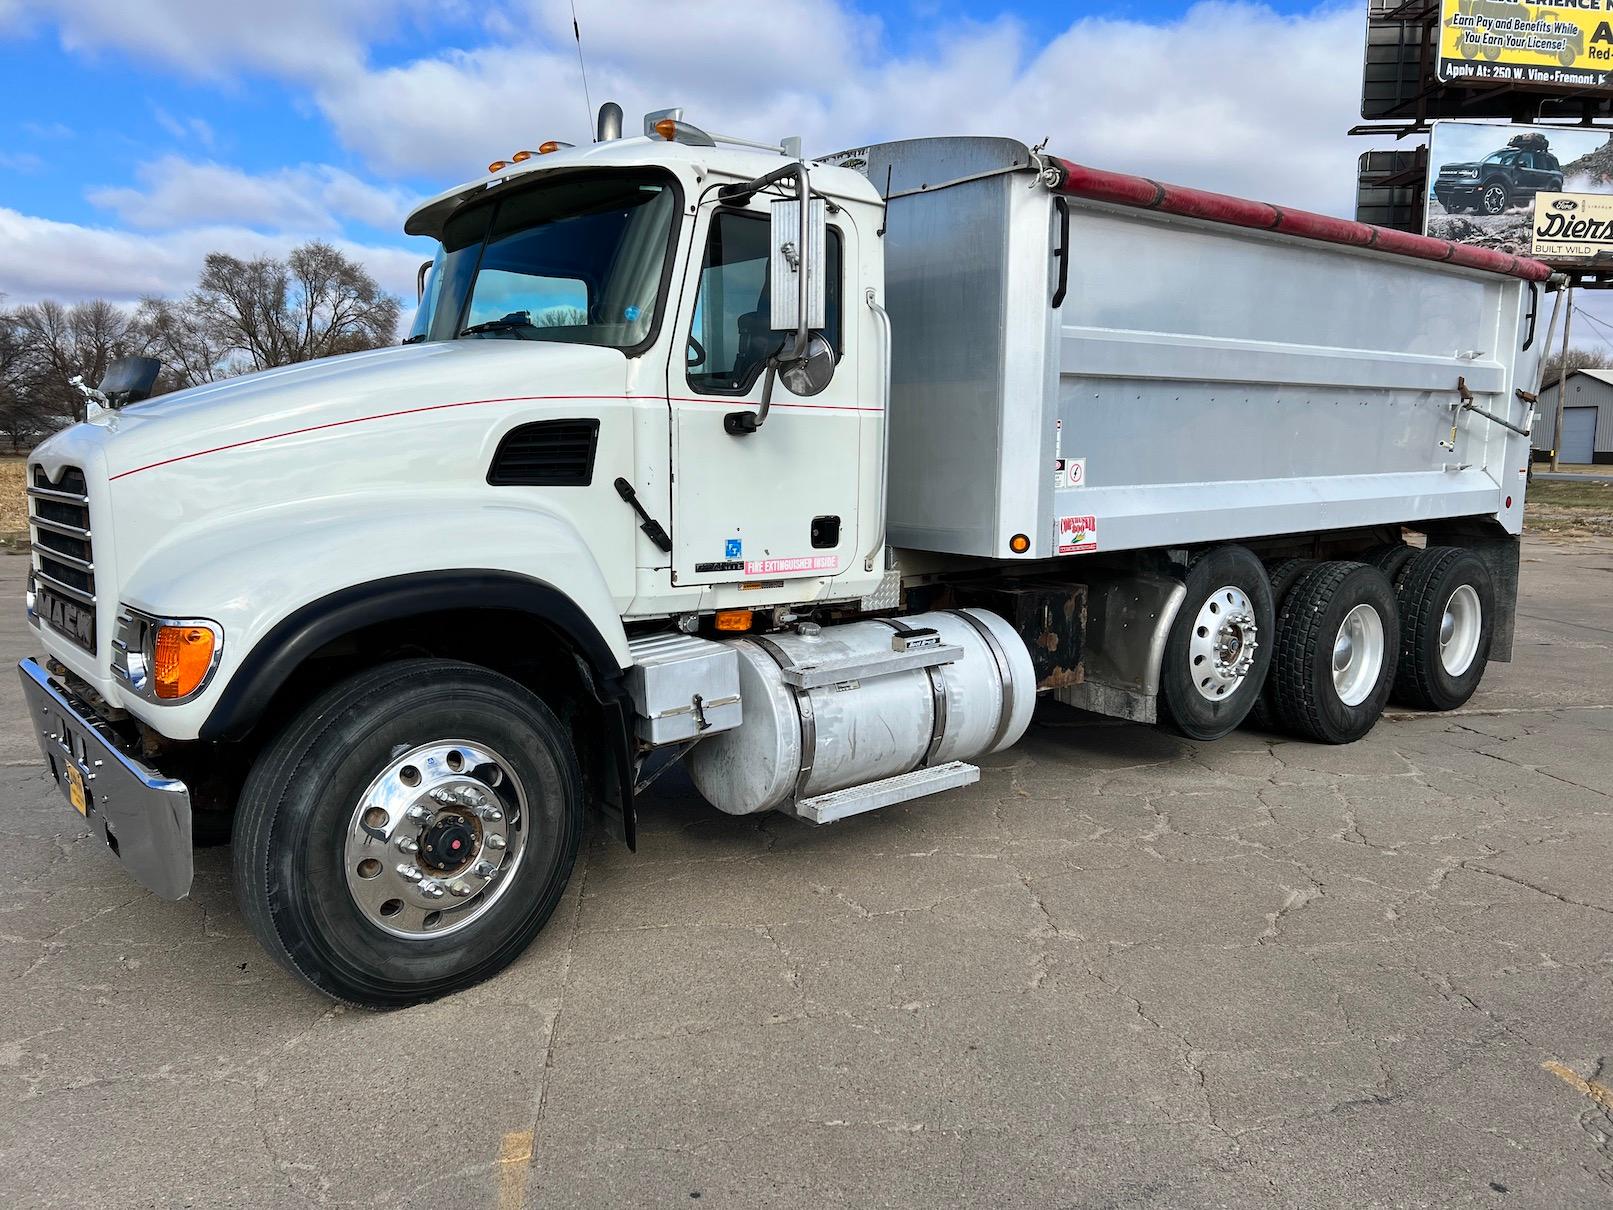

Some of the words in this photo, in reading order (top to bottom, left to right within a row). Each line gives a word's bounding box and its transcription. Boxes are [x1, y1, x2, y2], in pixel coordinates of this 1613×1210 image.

[1453, 14, 1474, 26] Earn
[1477, 15, 1493, 30] Pay
[1495, 19, 1512, 30] and
[1514, 19, 1551, 33] Benefits
[1554, 22, 1578, 35] While
[1465, 31, 1480, 43] You
[1483, 33, 1503, 46] Earn
[1506, 35, 1526, 47] Your
[1528, 37, 1566, 50] License!
[1446, 63, 1474, 78] Apply
[1476, 65, 1490, 77] At:
[1493, 66, 1511, 78] 250
[1537, 212, 1613, 240] Diers
[1536, 245, 1562, 253] BUILT
[1566, 246, 1591, 254] WILD
[748, 562, 764, 573] FIRE
[765, 559, 812, 571] EXTINGUISHER
[814, 557, 835, 568] INSIDE
